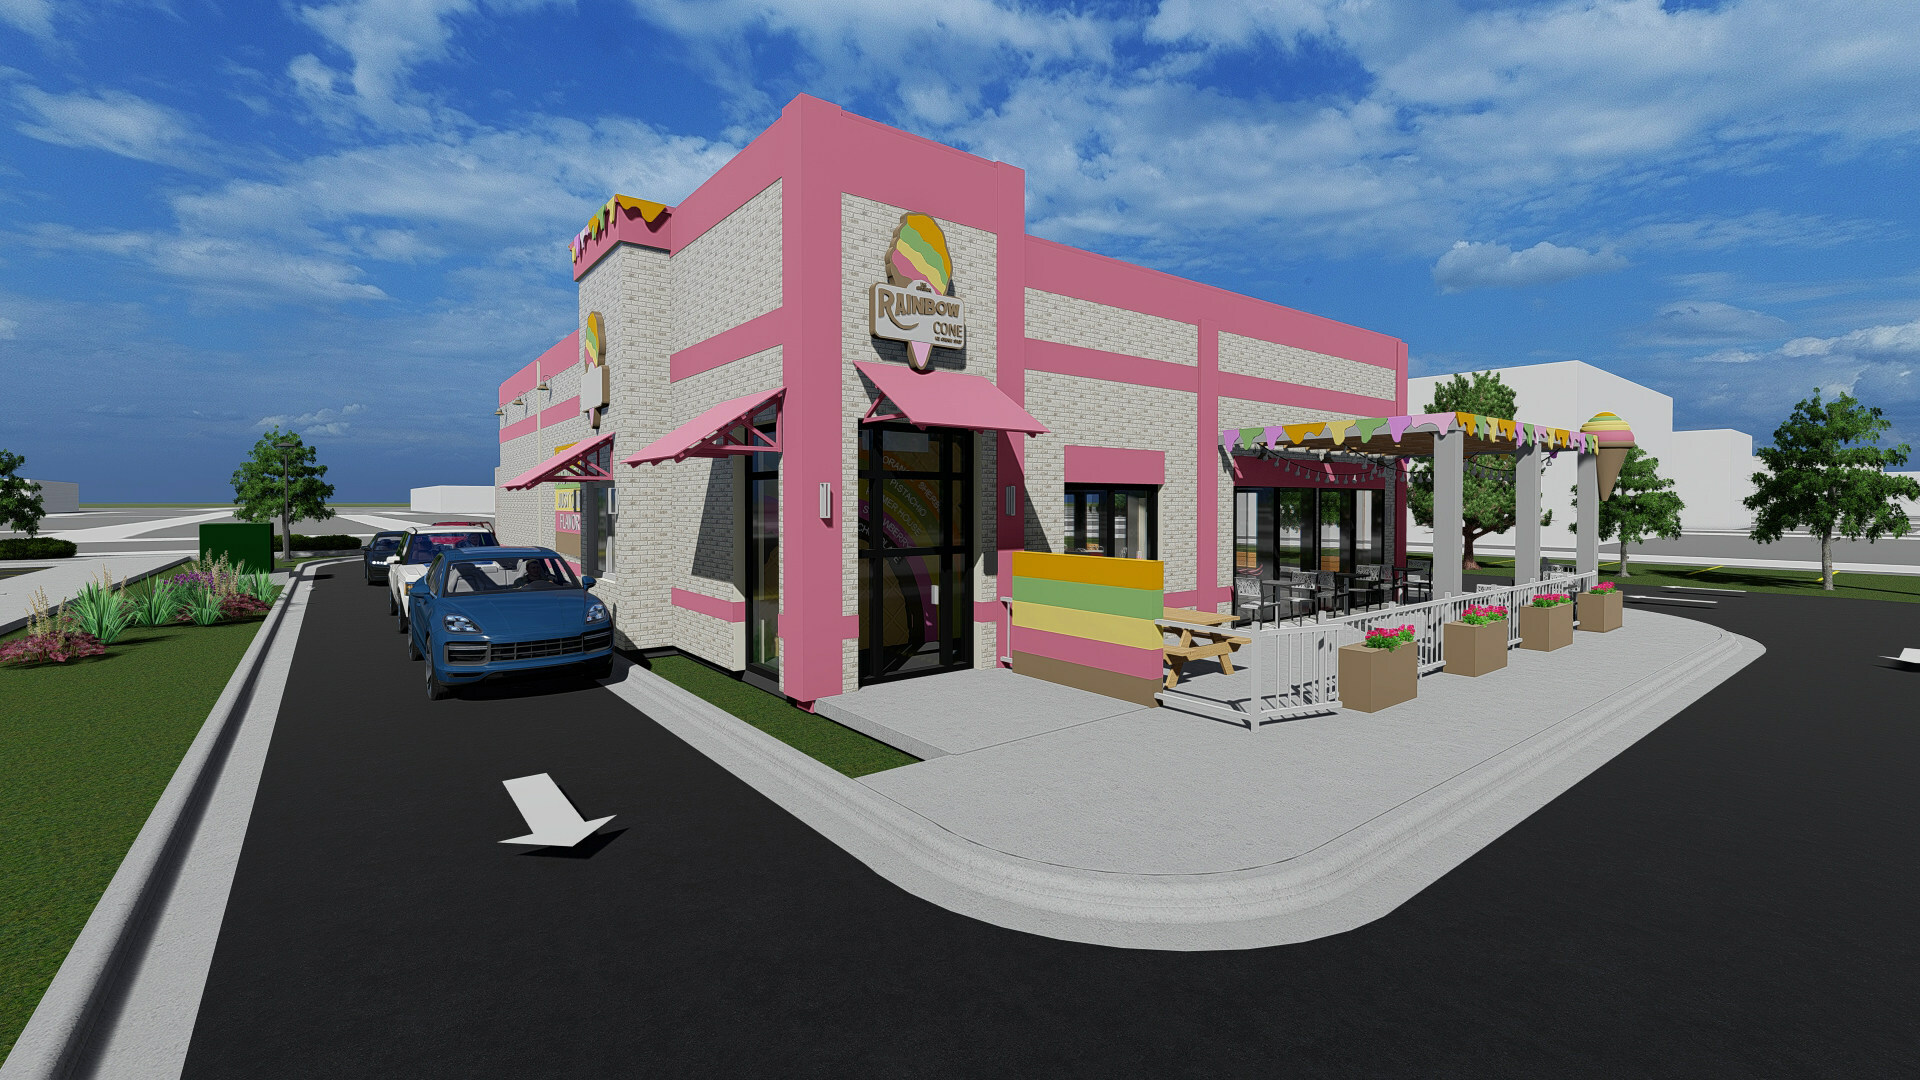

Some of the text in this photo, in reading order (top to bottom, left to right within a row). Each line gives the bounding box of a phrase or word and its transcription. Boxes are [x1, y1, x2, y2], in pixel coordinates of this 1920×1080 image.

[878, 288, 960, 330] RAINBOW
[933, 321, 963, 338] CONE
[889, 479, 928, 517] PISTACHIO
[560, 513, 581, 531] FLAVOR
[898, 508, 922, 537] HOUSE
